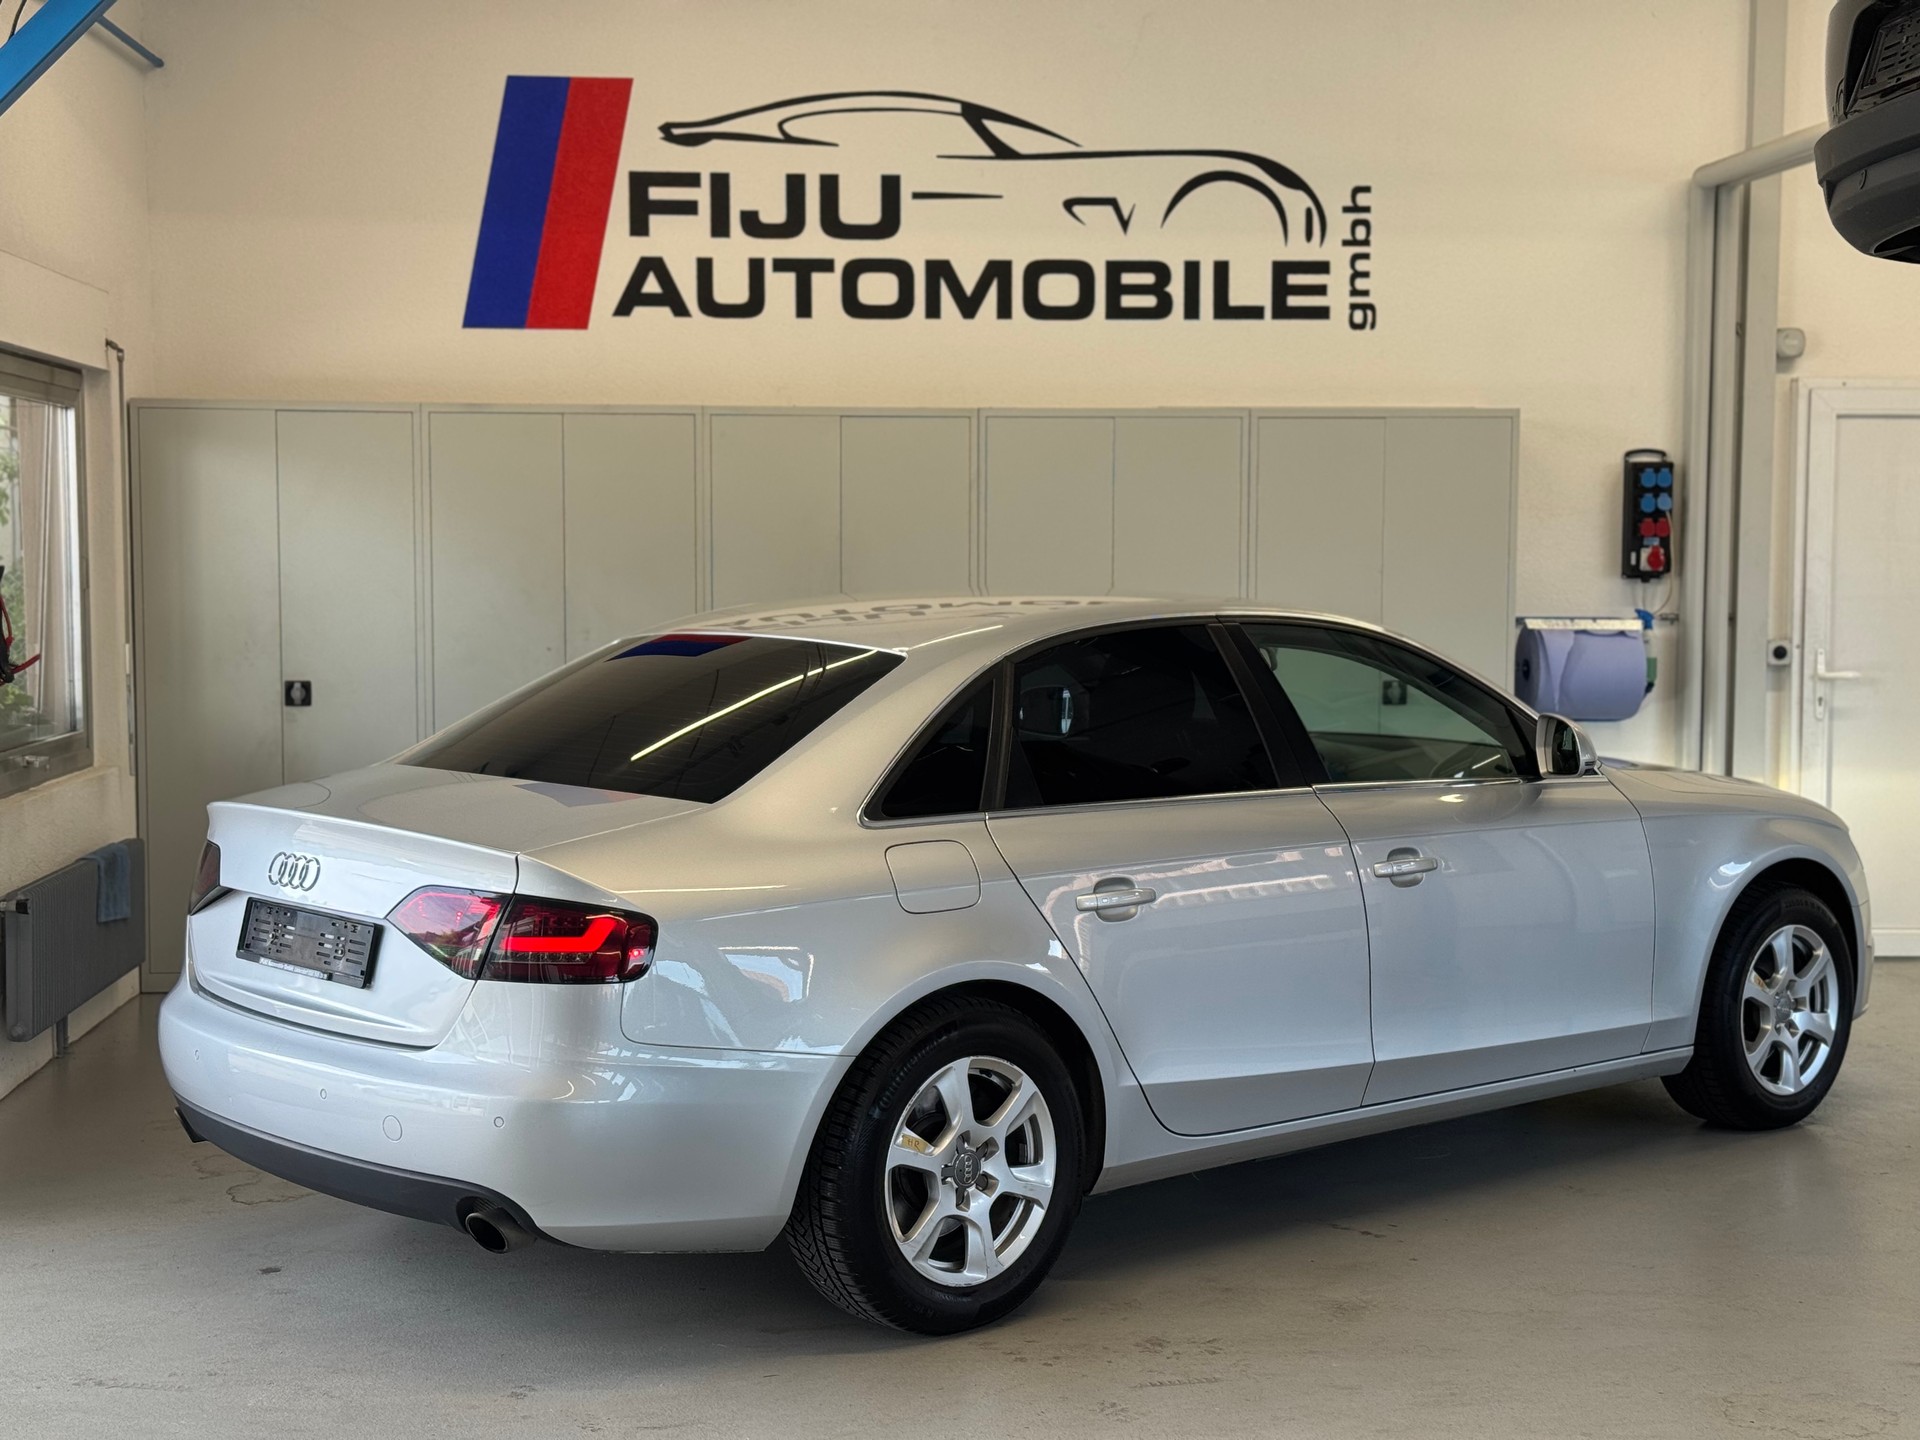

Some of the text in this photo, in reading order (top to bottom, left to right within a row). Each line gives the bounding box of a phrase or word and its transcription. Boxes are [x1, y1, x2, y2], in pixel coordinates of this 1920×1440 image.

[629, 171, 900, 240] FIJU
[614, 257, 1330, 320] AUTOMOBILE
[1342, 186, 1376, 330] gmbh
